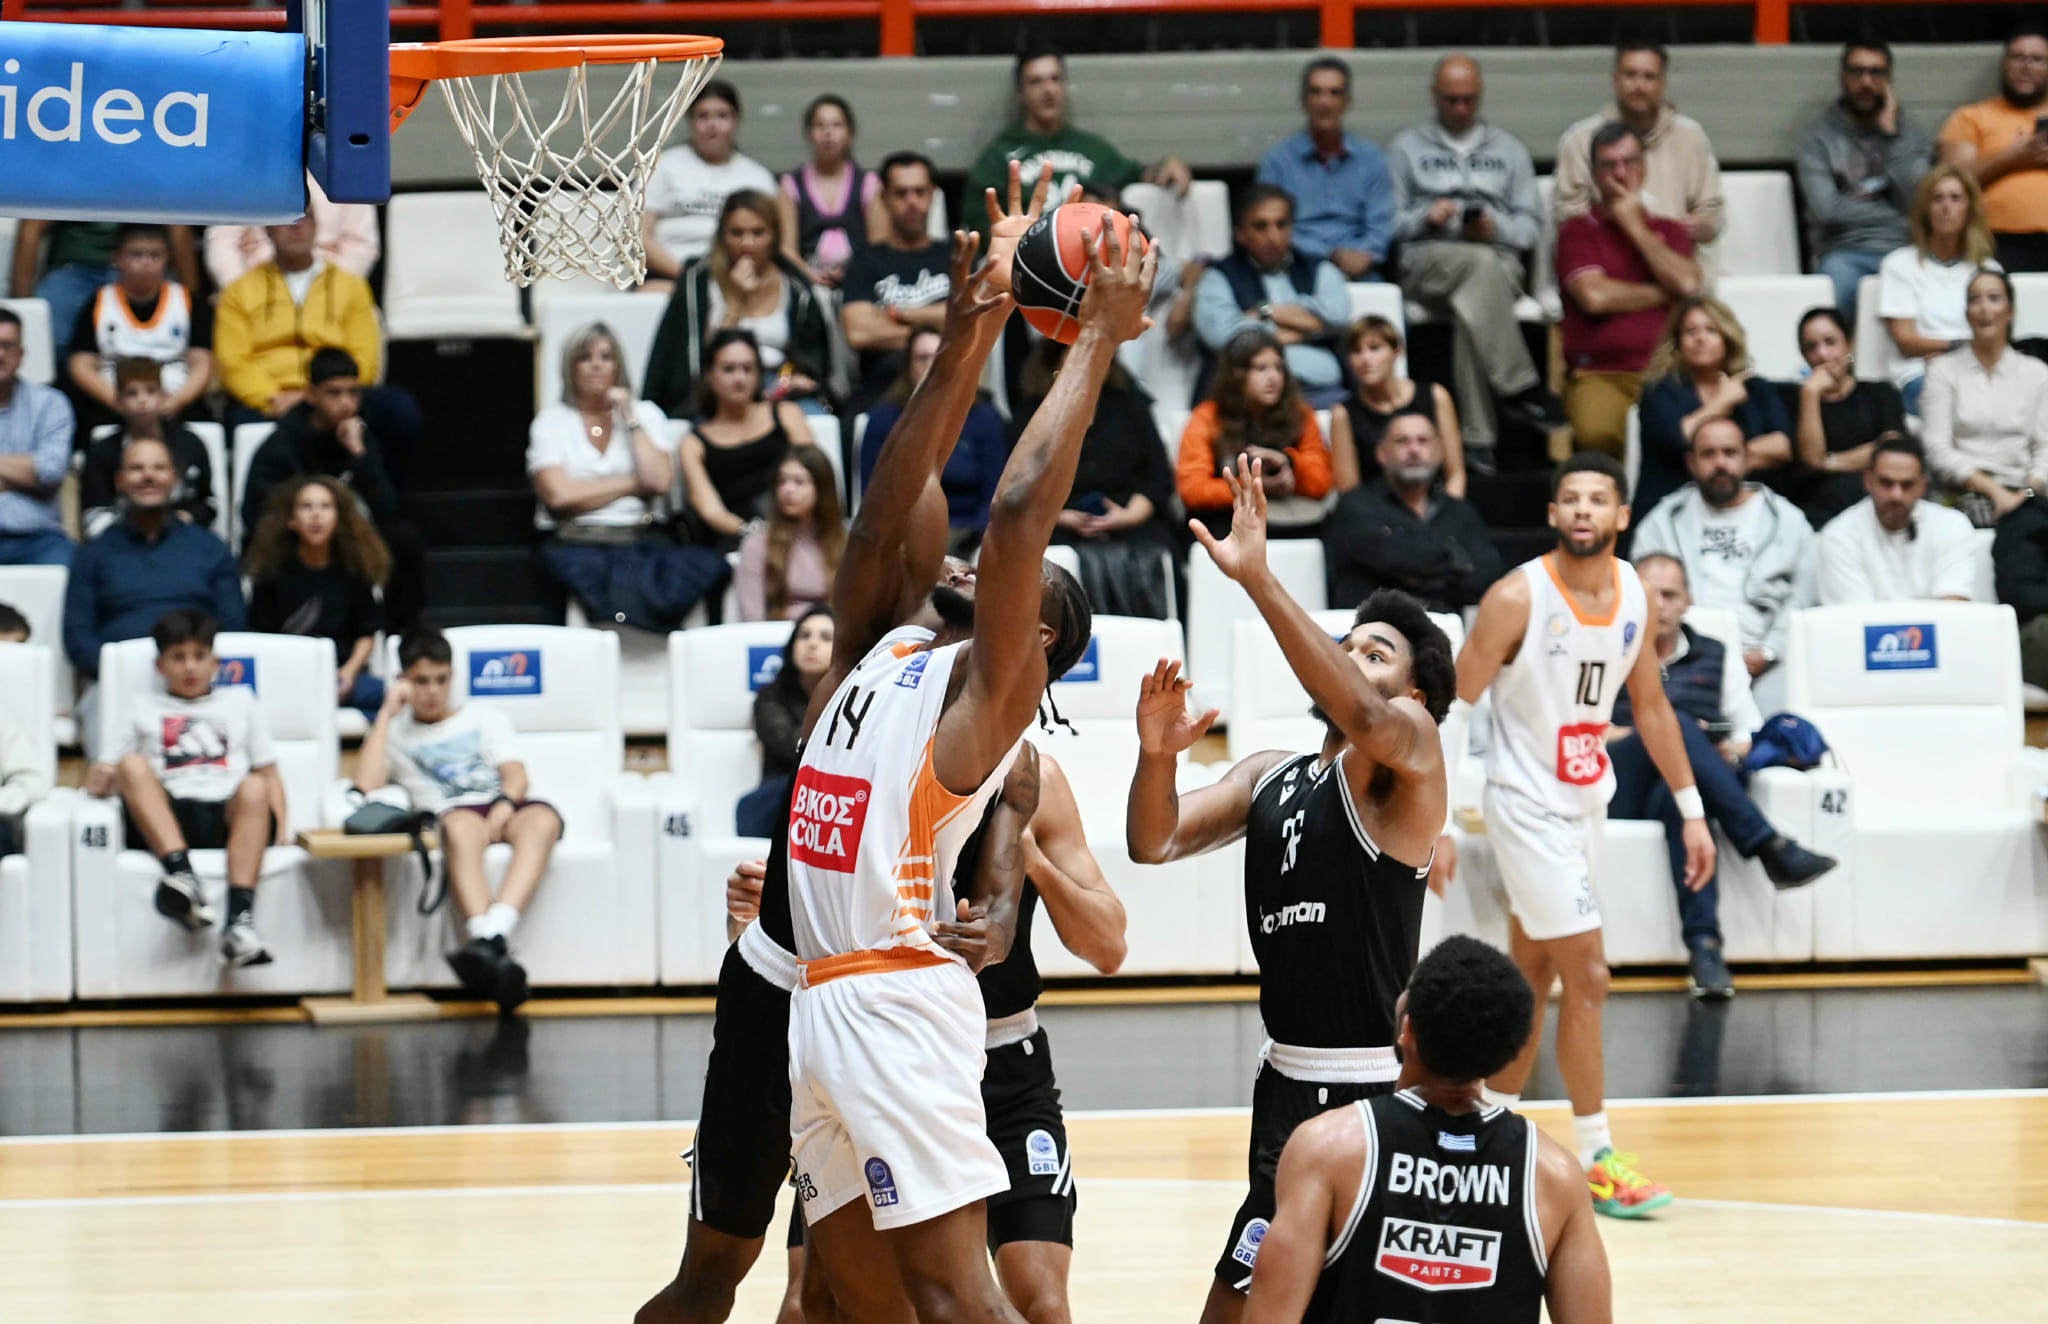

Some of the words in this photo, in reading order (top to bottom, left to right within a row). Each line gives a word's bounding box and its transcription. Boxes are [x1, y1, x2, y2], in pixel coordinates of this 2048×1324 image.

[1575, 660, 1606, 706] 10
[826, 685, 875, 750] 14
[1821, 788, 1848, 815] 42
[790, 817, 846, 857] COLA
[1032, 1163, 1058, 1173] GBL
[1388, 1152, 1510, 1206] BROWN
[874, 1192, 897, 1206] GBL
[1383, 1222, 1497, 1261] KRAFT
